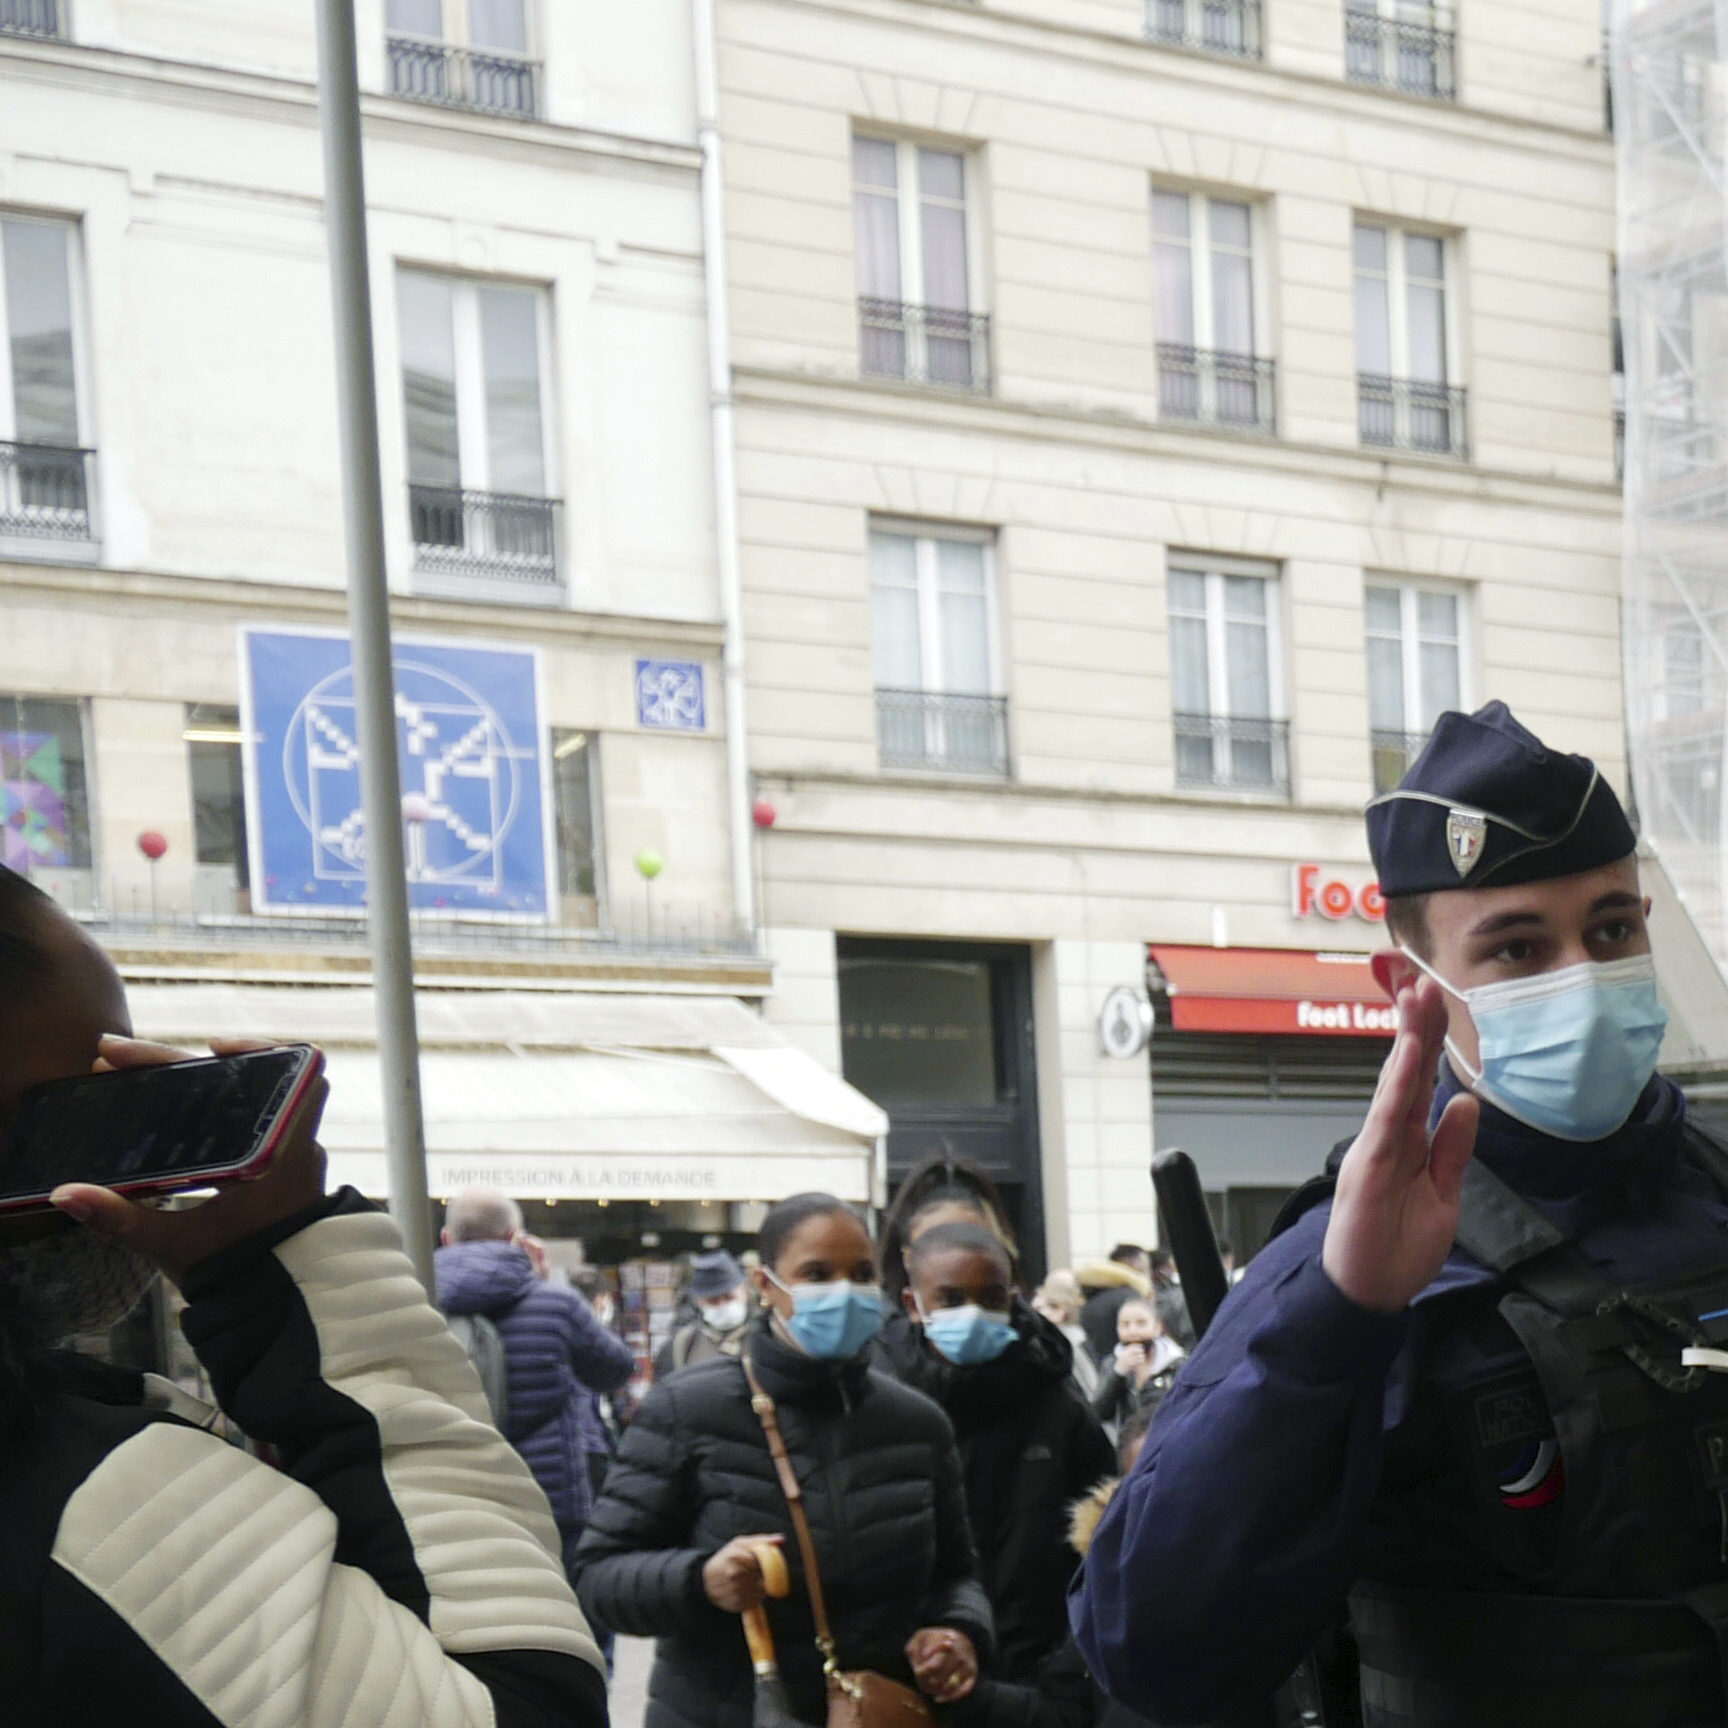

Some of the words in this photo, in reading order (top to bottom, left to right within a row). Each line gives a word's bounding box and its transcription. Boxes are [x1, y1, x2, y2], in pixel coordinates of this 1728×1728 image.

[1297, 1001, 1350, 1030] Foot
[441, 1166, 564, 1189] IMPRESSION
[588, 1168, 612, 1188] LA
[617, 1169, 719, 1189] DEMANDE
